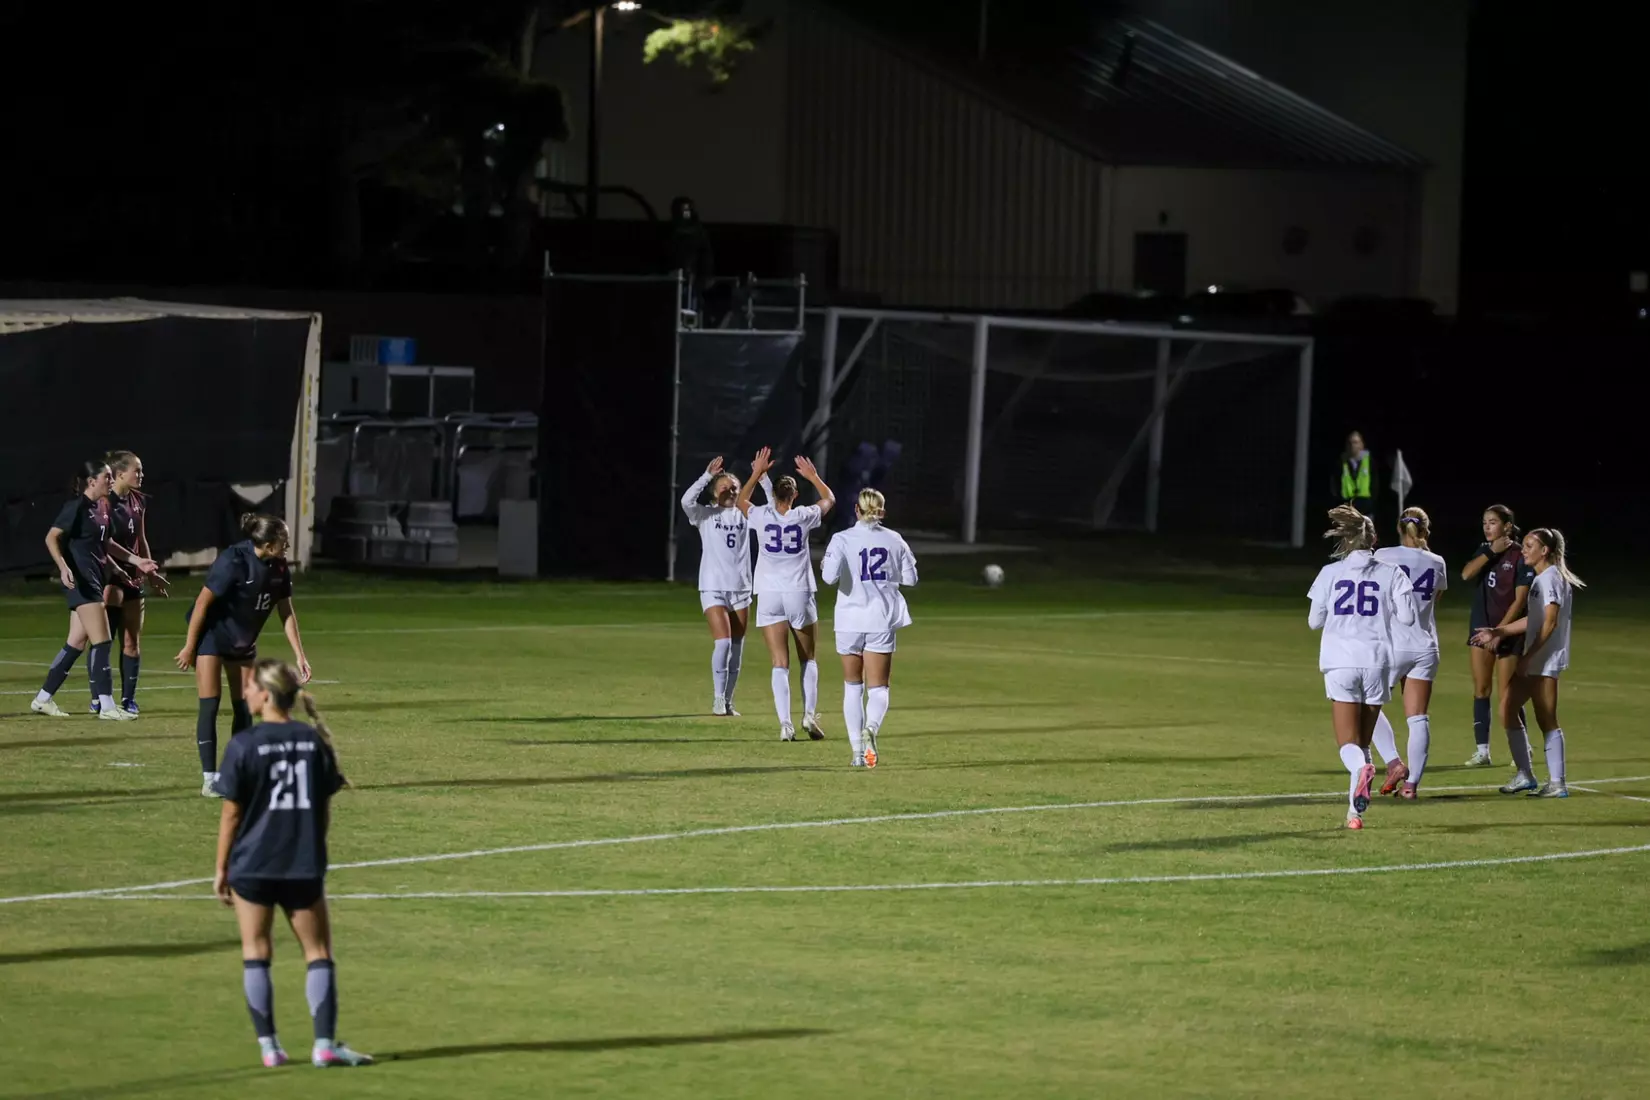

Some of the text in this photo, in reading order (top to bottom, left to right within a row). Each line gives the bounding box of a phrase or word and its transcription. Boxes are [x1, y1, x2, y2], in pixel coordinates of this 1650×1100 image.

[99, 525, 106, 541] 7
[128, 518, 135, 534] 4
[726, 533, 737, 549] 6
[764, 523, 803, 555] 33
[859, 547, 888, 582] 12
[1487, 571, 1497, 588] 5
[254, 593, 271, 611] 12
[1334, 579, 1380, 617] 26
[269, 759, 312, 811] 21
